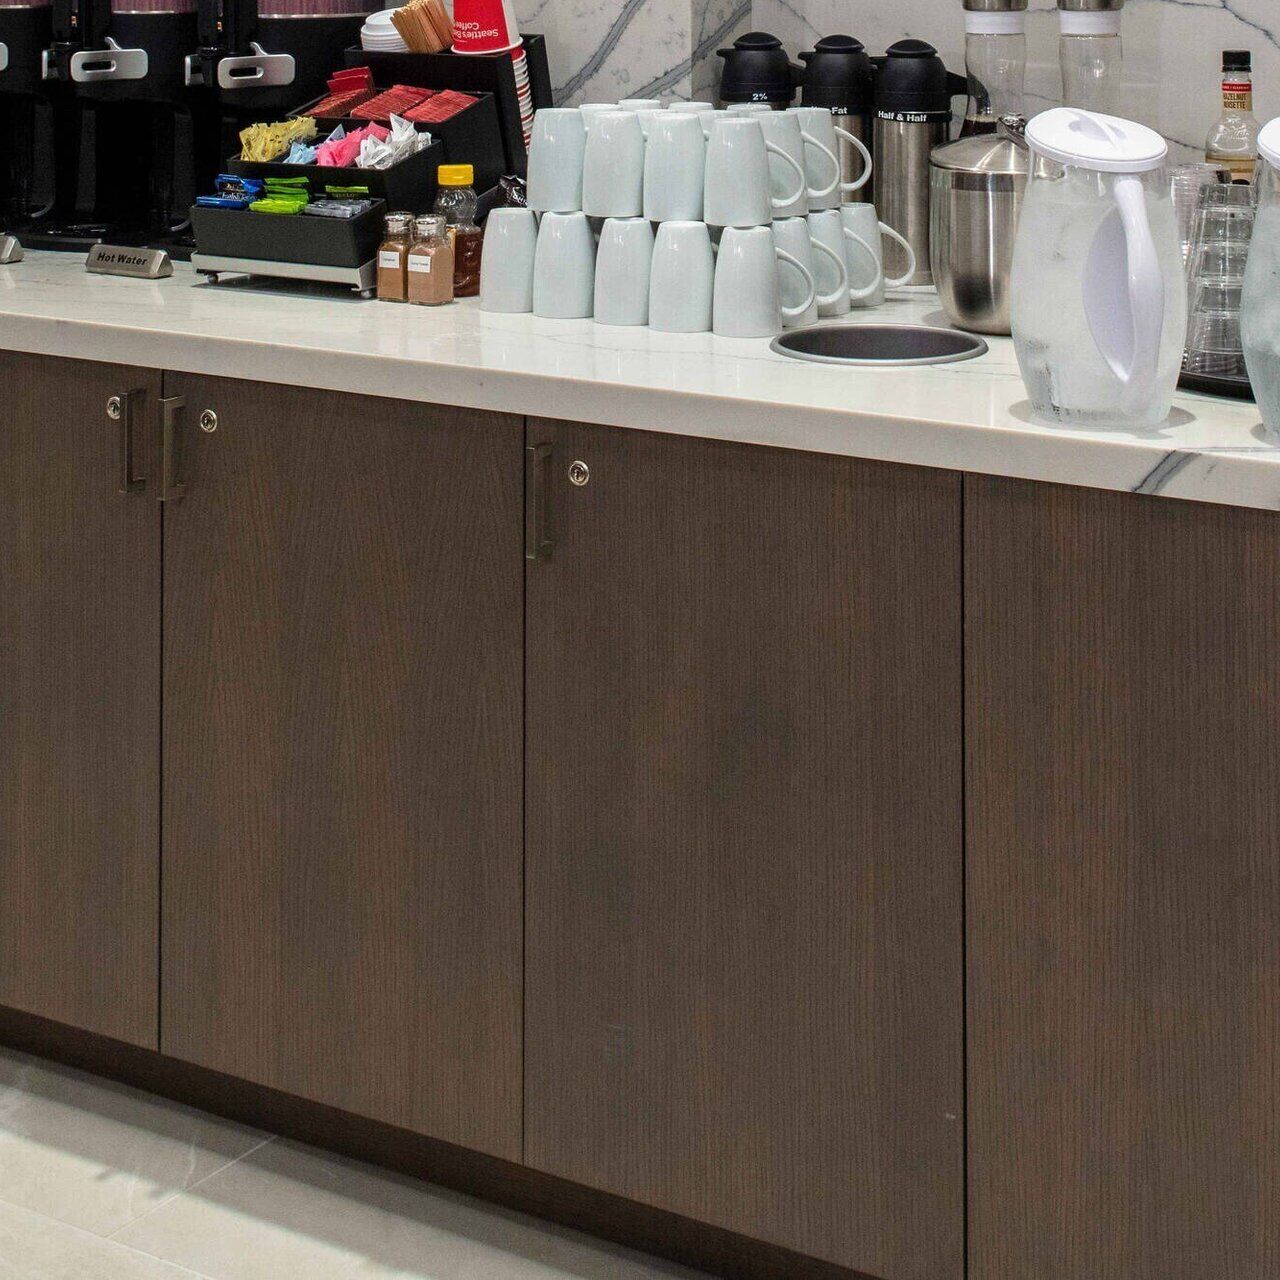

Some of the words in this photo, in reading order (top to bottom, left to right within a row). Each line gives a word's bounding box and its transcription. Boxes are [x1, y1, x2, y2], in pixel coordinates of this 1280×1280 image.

[752, 93, 768, 101] 2%
[878, 110, 894, 120] Half
[907, 114, 927, 122] Half
[97, 251, 116, 263] Hot
[117, 254, 148, 266] Water
